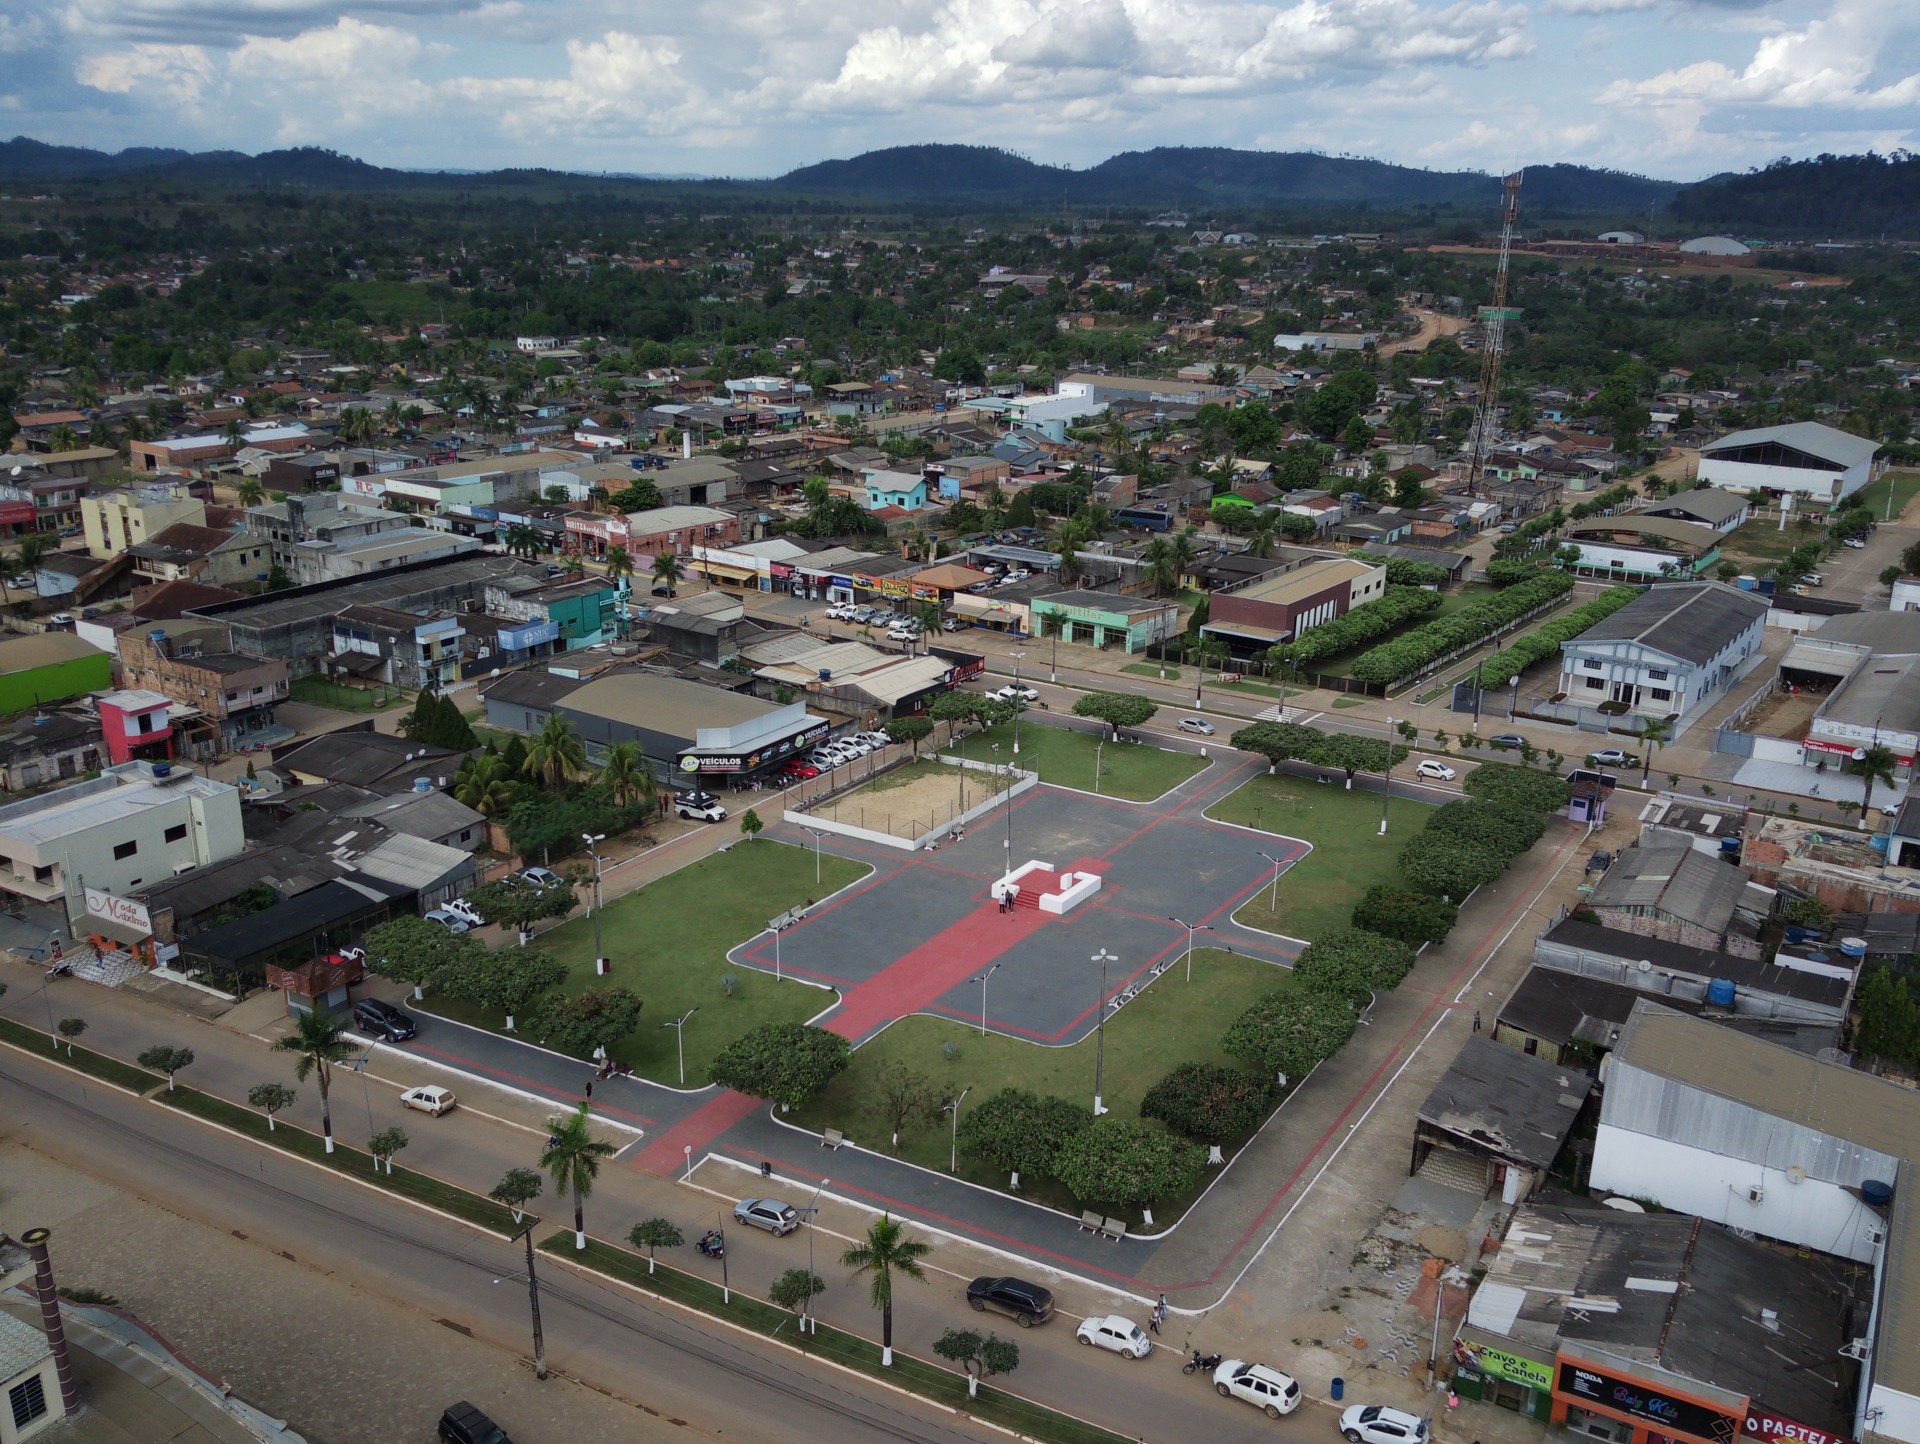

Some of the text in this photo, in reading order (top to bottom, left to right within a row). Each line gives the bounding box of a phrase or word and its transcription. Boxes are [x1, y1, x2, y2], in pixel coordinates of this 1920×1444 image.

[701, 757, 742, 766] VEÍCULOS
[1479, 1346, 1529, 1370] Cravo e
[1503, 1363, 1547, 1384] Canela
[1574, 1369, 1603, 1385] MODA
[1613, 1386, 1644, 1410] Baby
[1648, 1397, 1679, 1420] Kids
[1746, 1417, 1759, 1432] O
